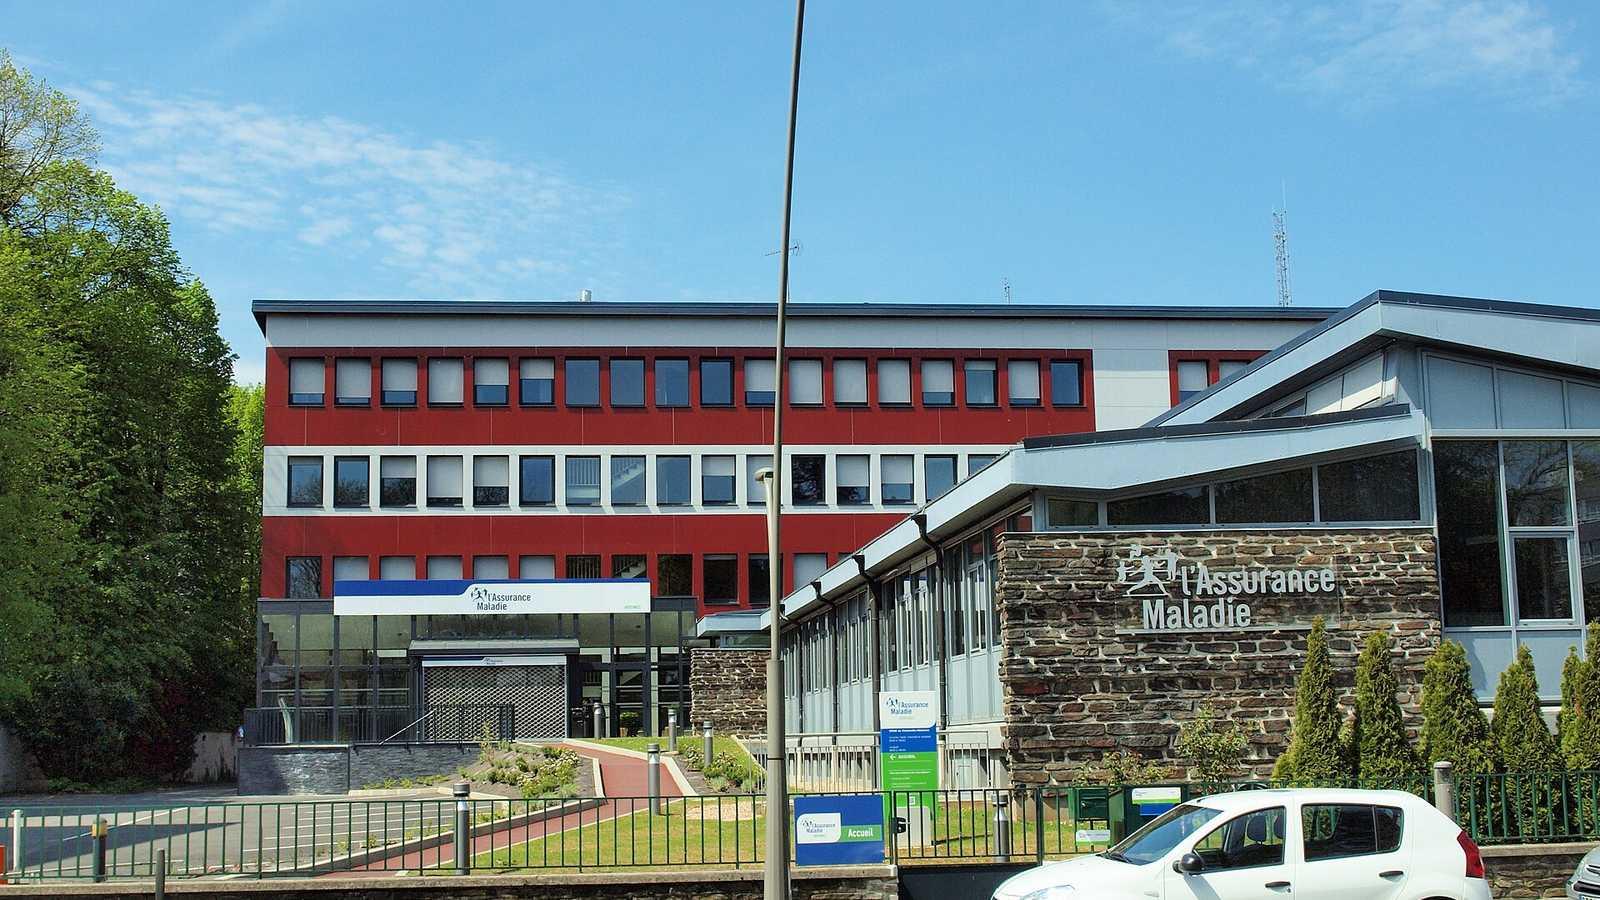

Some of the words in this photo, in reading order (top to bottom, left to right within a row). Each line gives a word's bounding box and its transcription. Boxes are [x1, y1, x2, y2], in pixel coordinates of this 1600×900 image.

[1181, 565, 1336, 596] l'Assurance
[487, 593, 532, 602] l'Assurance
[477, 602, 508, 611] Maladie
[1142, 596, 1251, 629] Maladie
[848, 828, 874, 838] Accueil
